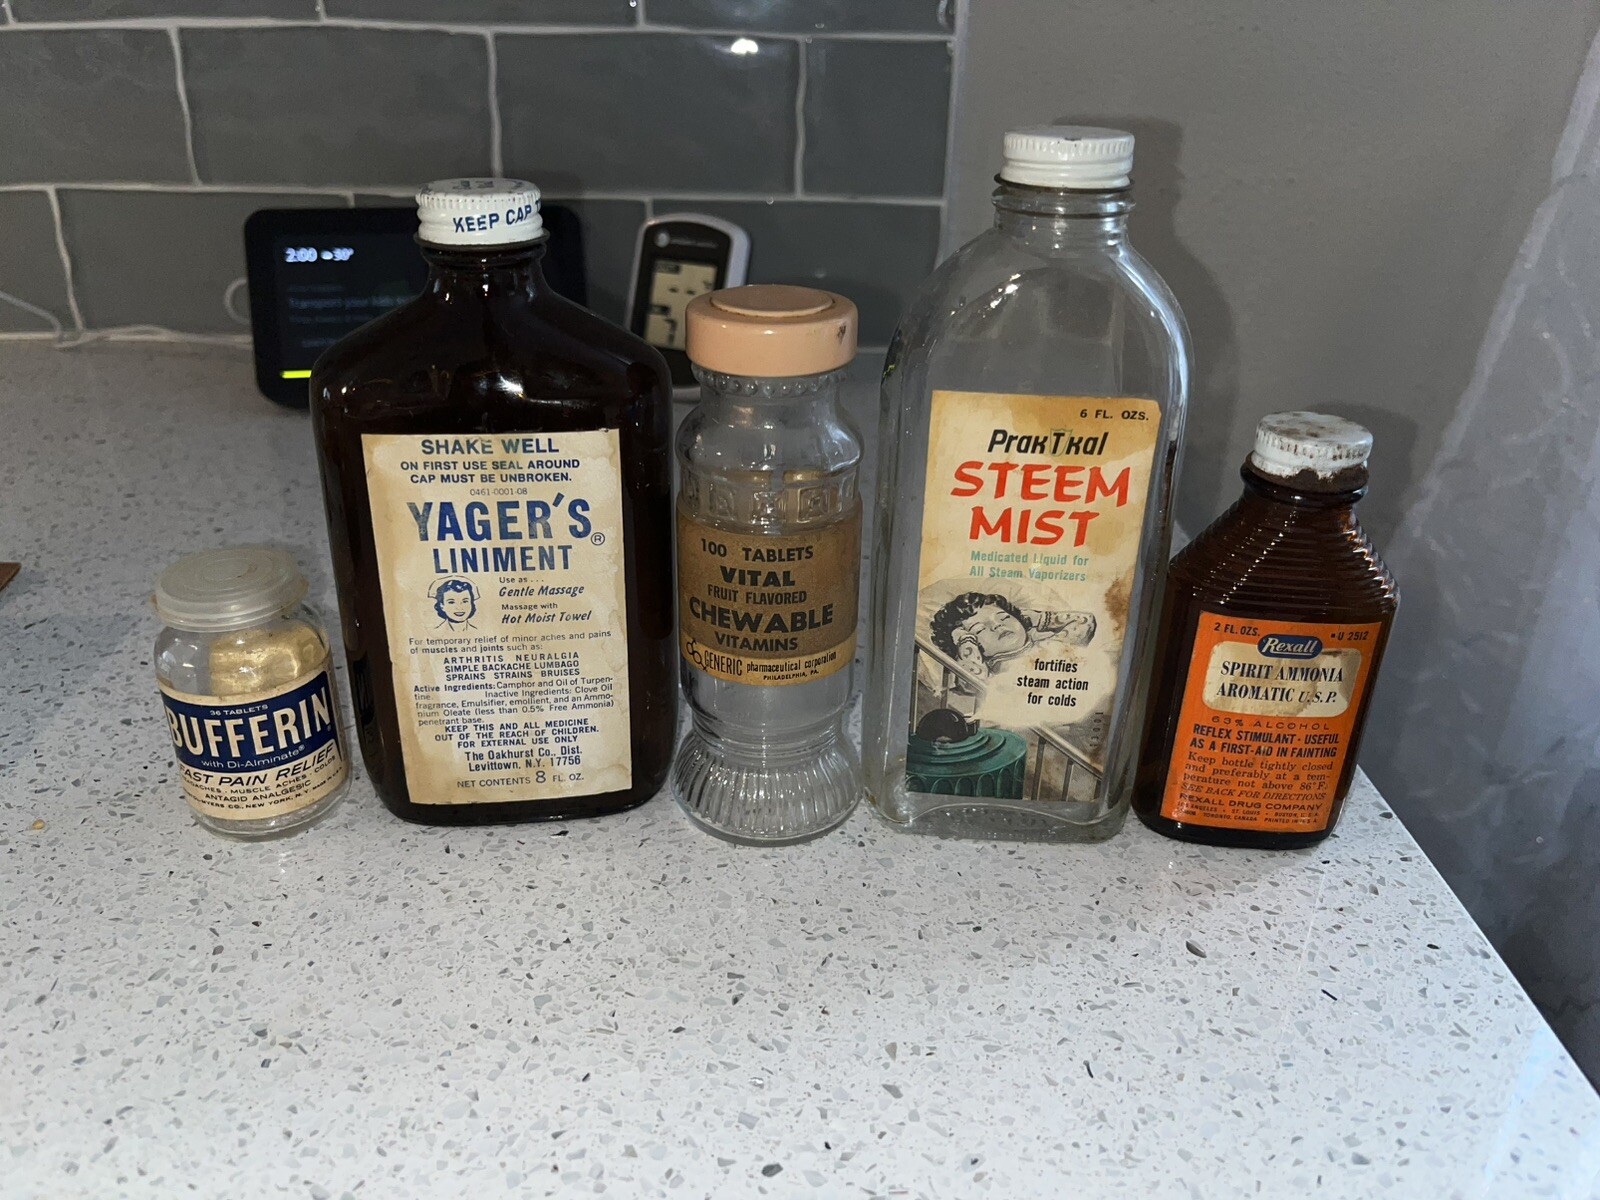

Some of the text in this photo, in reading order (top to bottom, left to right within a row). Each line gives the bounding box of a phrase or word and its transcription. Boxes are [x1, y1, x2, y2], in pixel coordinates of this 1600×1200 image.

[453, 213, 499, 232] KEEP
[506, 205, 532, 225] CAP
[1080, 409, 1149, 421] 6 FL. OZS.
[421, 438, 559, 455] SHAKE WELL
[400, 460, 580, 470] ON FIRST USE SEAL AROUND
[410, 473, 572, 483] CAP MUST BE UNBROKEN.
[951, 461, 1130, 507] STEEM
[470, 488, 528, 496] 0461-0001-08
[406, 493, 591, 541] YAGER'S
[969, 506, 1100, 547] MIST
[701, 538, 813, 562] 100 TABLETS
[433, 545, 573, 573] LINIMENT
[971, 551, 1089, 566] Medicated for
[720, 565, 795, 587] VITAL
[970, 566, 1086, 582] All Steam Vaporizers
[499, 585, 584, 597] Gentle Massage
[708, 584, 807, 605] FRUIT FLAVORED
[502, 610, 592, 623] Hot Moist Towel
[690, 596, 833, 633] CHEWABLE
[1214, 622, 1260, 636] 2 FL. OZS.
[1347, 631, 1369, 641] 2512
[427, 638, 471, 646] temporary
[589, 630, 611, 639] pains
[715, 631, 798, 651] VITAMINS
[1262, 637, 1317, 655] Rexall
[480, 645, 504, 653] joints
[444, 651, 579, 664] ARTHRITIS NEURALGIA
[482, 663, 531, 671] BACKACHE
[534, 660, 579, 669] LUMBAGO
[704, 650, 836, 676] GENERIC pharmaceutical corporation
[1035, 658, 1077, 673] fortifies
[446, 669, 580, 681] SPRAINS STRAINS BRUISES
[1221, 661, 1343, 682] SPIRIT AMMONIA
[445, 684, 495, 692] Ingredients:
[496, 680, 535, 689] Camphor
[581, 677, 613, 685] Turpen-
[1017, 675, 1088, 691] steam action
[522, 688, 571, 697] Ingredients:
[1028, 692, 1076, 707] for colds
[1217, 682, 1295, 702] AROMATIC
[223, 704, 268, 715] TABLETS
[165, 686, 330, 758] BUFFERIN
[545, 718, 588, 728] MEDICINE
[1253, 721, 1329, 730] ALCOHOL
[500, 730, 529, 738] REACH
[552, 726, 599, 735] CHILDREN.
[1193, 723, 1339, 744] REFLEX STIMULANT USEFUL
[481, 739, 526, 747] EXTERNAL
[532, 737, 549, 745] USE
[555, 735, 578, 743] ONLY
[1190, 737, 1337, 758] AS A FIRST-AID IN FAINTING
[465, 745, 582, 761] The Oakhurst Dist.
[551, 756, 581, 766] 17756
[1188, 751, 1333, 771] Keep bottle tightly closed
[201, 760, 224, 769] with
[218, 774, 268, 787] PAIN
[276, 743, 333, 780] RELIEF
[457, 780, 476, 788] NET
[479, 777, 531, 787] CONTENTS
[536, 771, 546, 783] 8
[569, 773, 584, 781] OZ.
[1212, 767, 1270, 780] preferably
[1180, 793, 1322, 811] REXALL DRUG COMPANY
